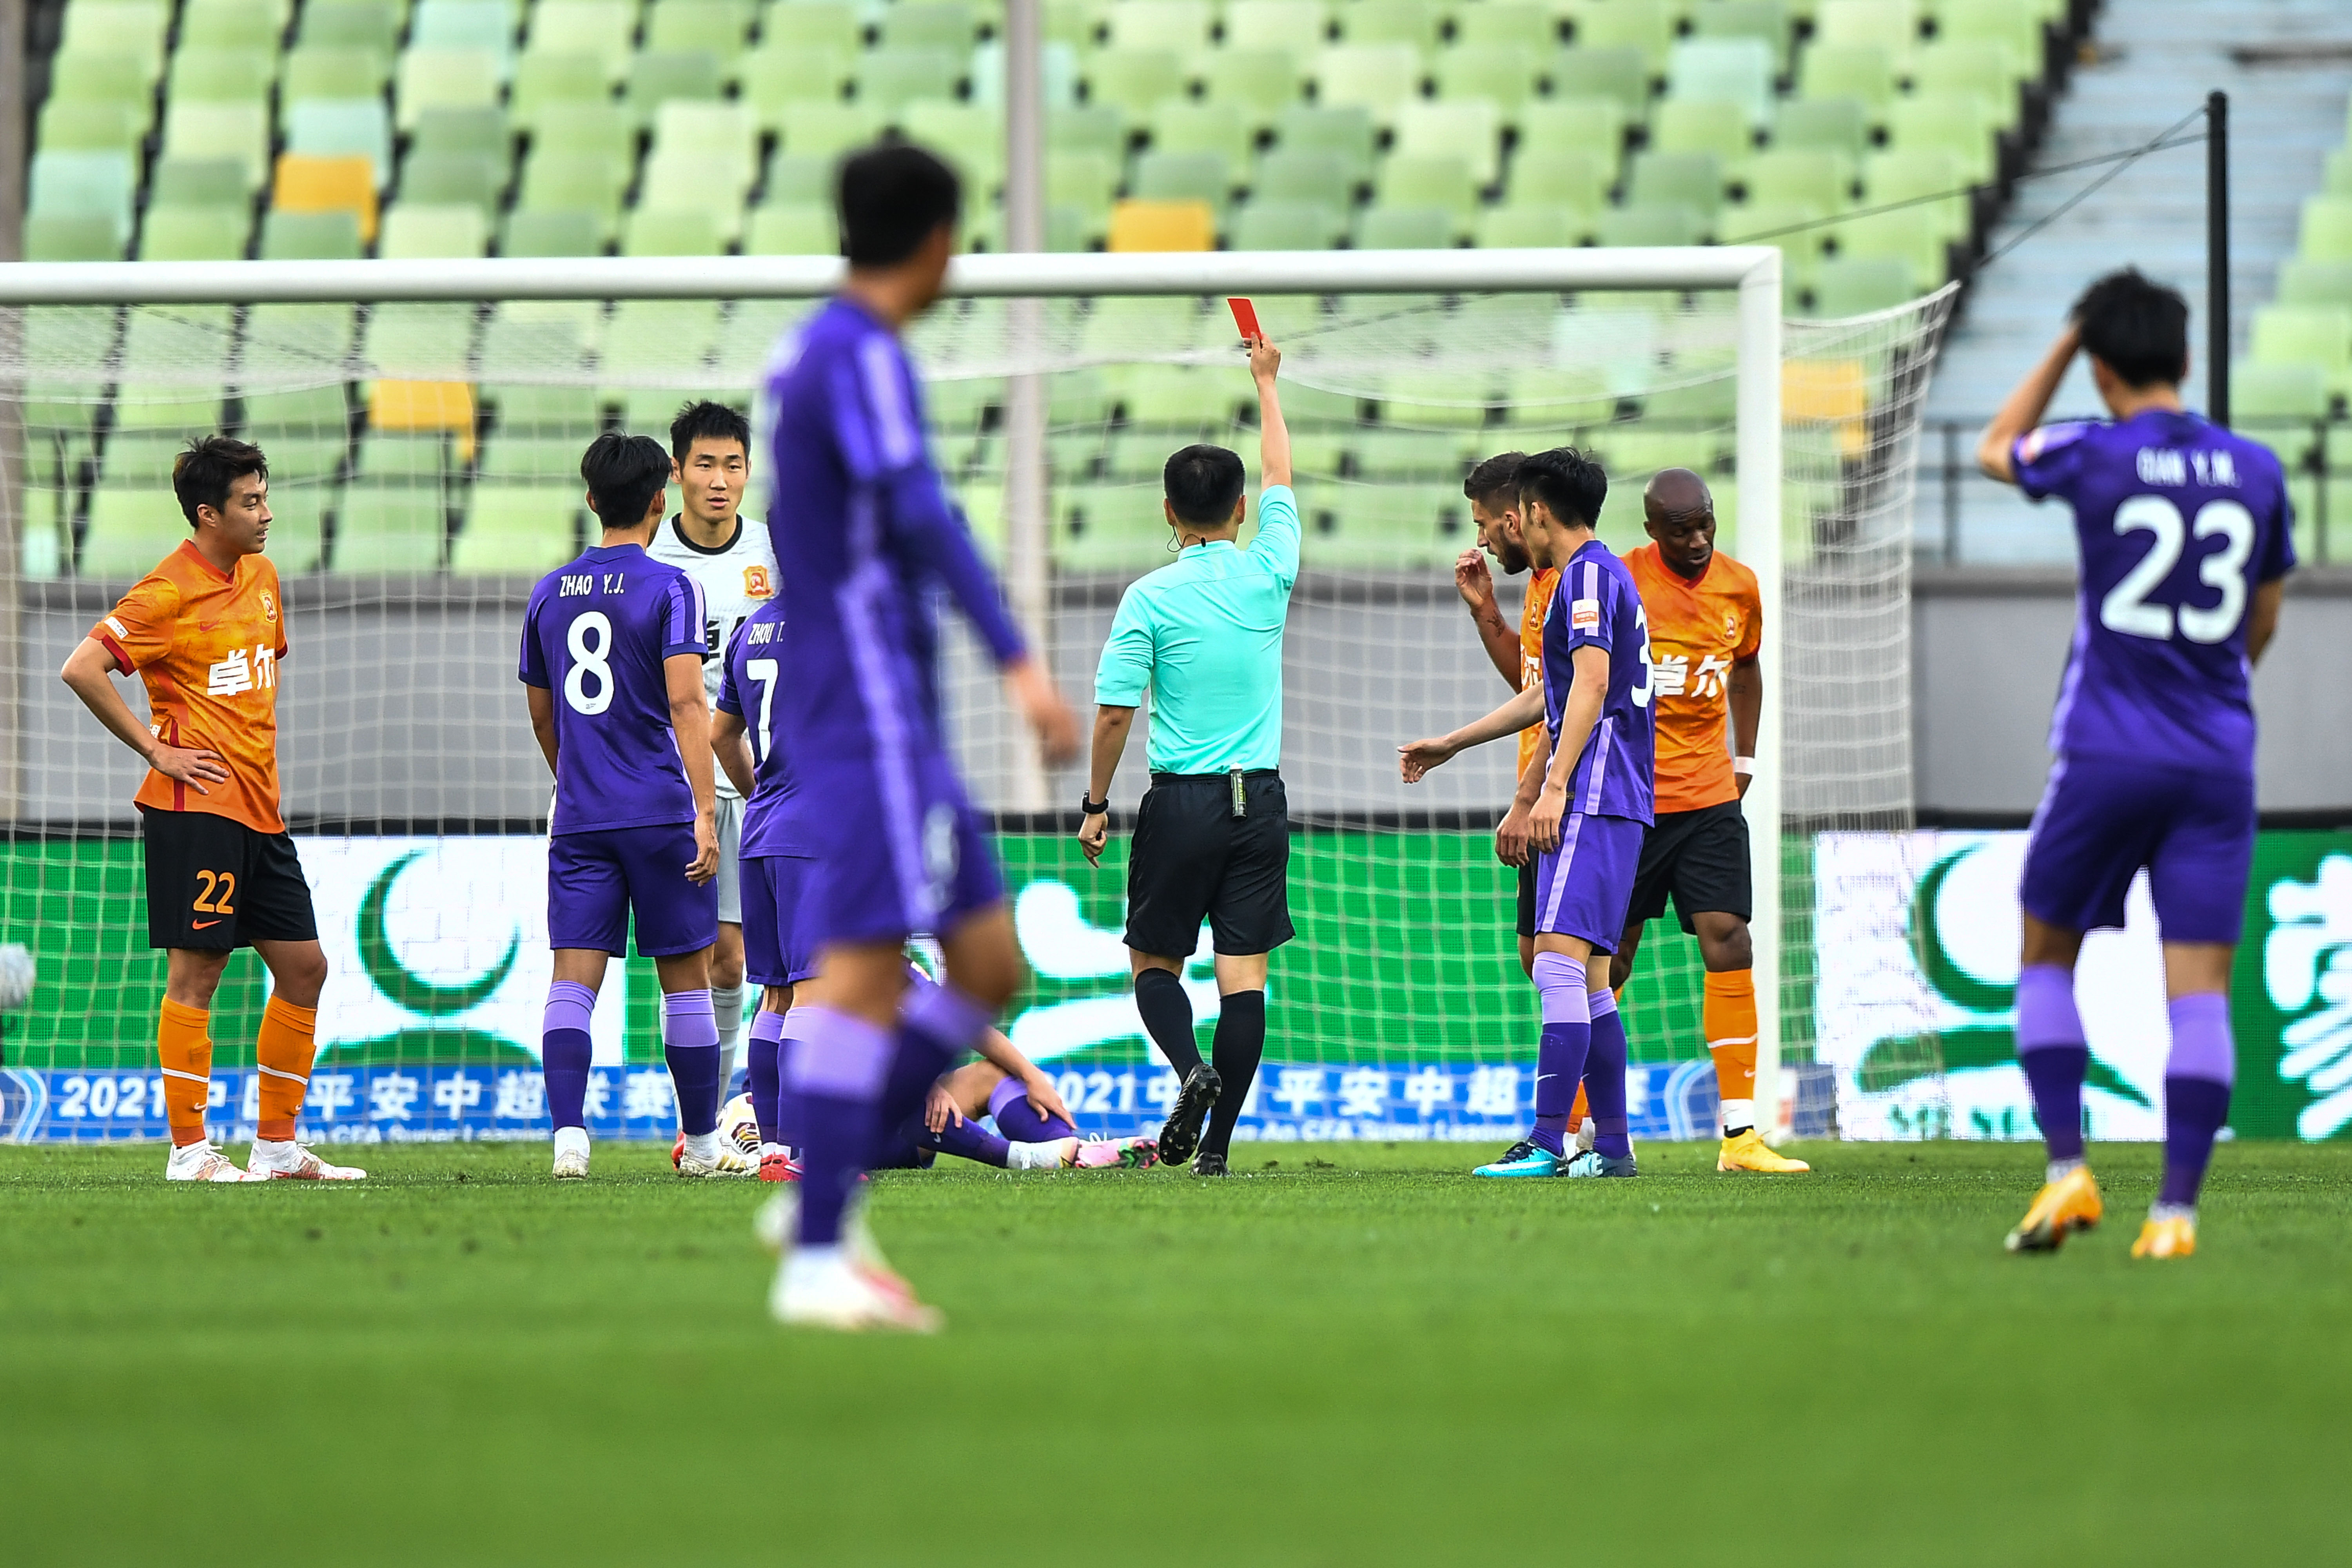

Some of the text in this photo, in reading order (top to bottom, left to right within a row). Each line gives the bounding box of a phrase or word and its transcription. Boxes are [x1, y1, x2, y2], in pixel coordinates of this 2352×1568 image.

[559, 573, 624, 597] ZHAO Y.J.
[2100, 494, 2256, 644] 23
[748, 622, 775, 645] ZHOU
[207, 644, 276, 696] 卓尔
[564, 611, 614, 715] 8
[746, 659, 779, 762] 7
[193, 870, 235, 914] 22
